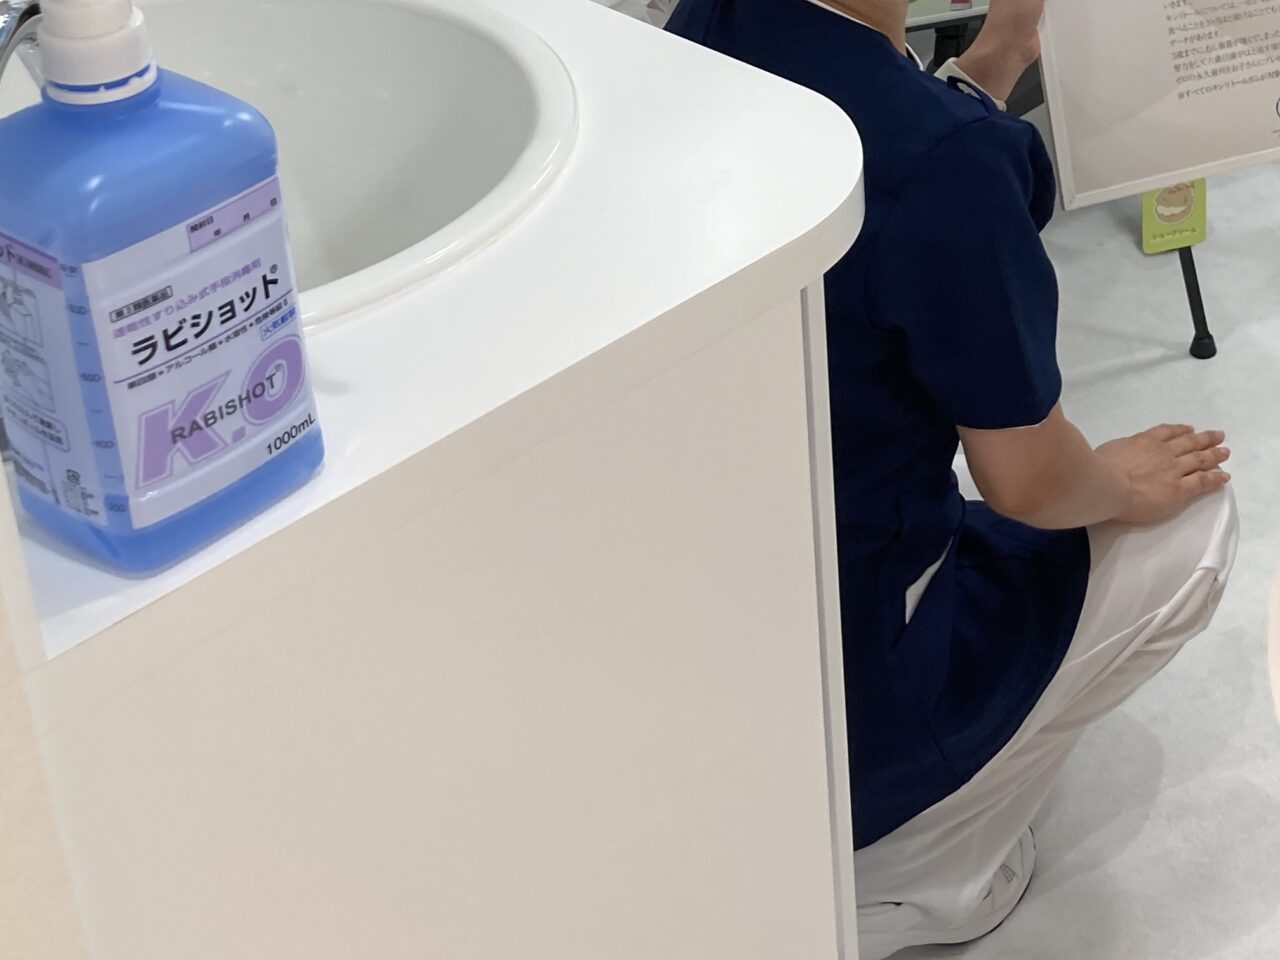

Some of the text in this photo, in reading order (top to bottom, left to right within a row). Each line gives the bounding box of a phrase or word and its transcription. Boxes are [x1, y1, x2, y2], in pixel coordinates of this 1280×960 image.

[130, 273, 279, 366] ラビショット
[170, 371, 276, 444] RABISHOT
[266, 413, 316, 456] 1000mL
